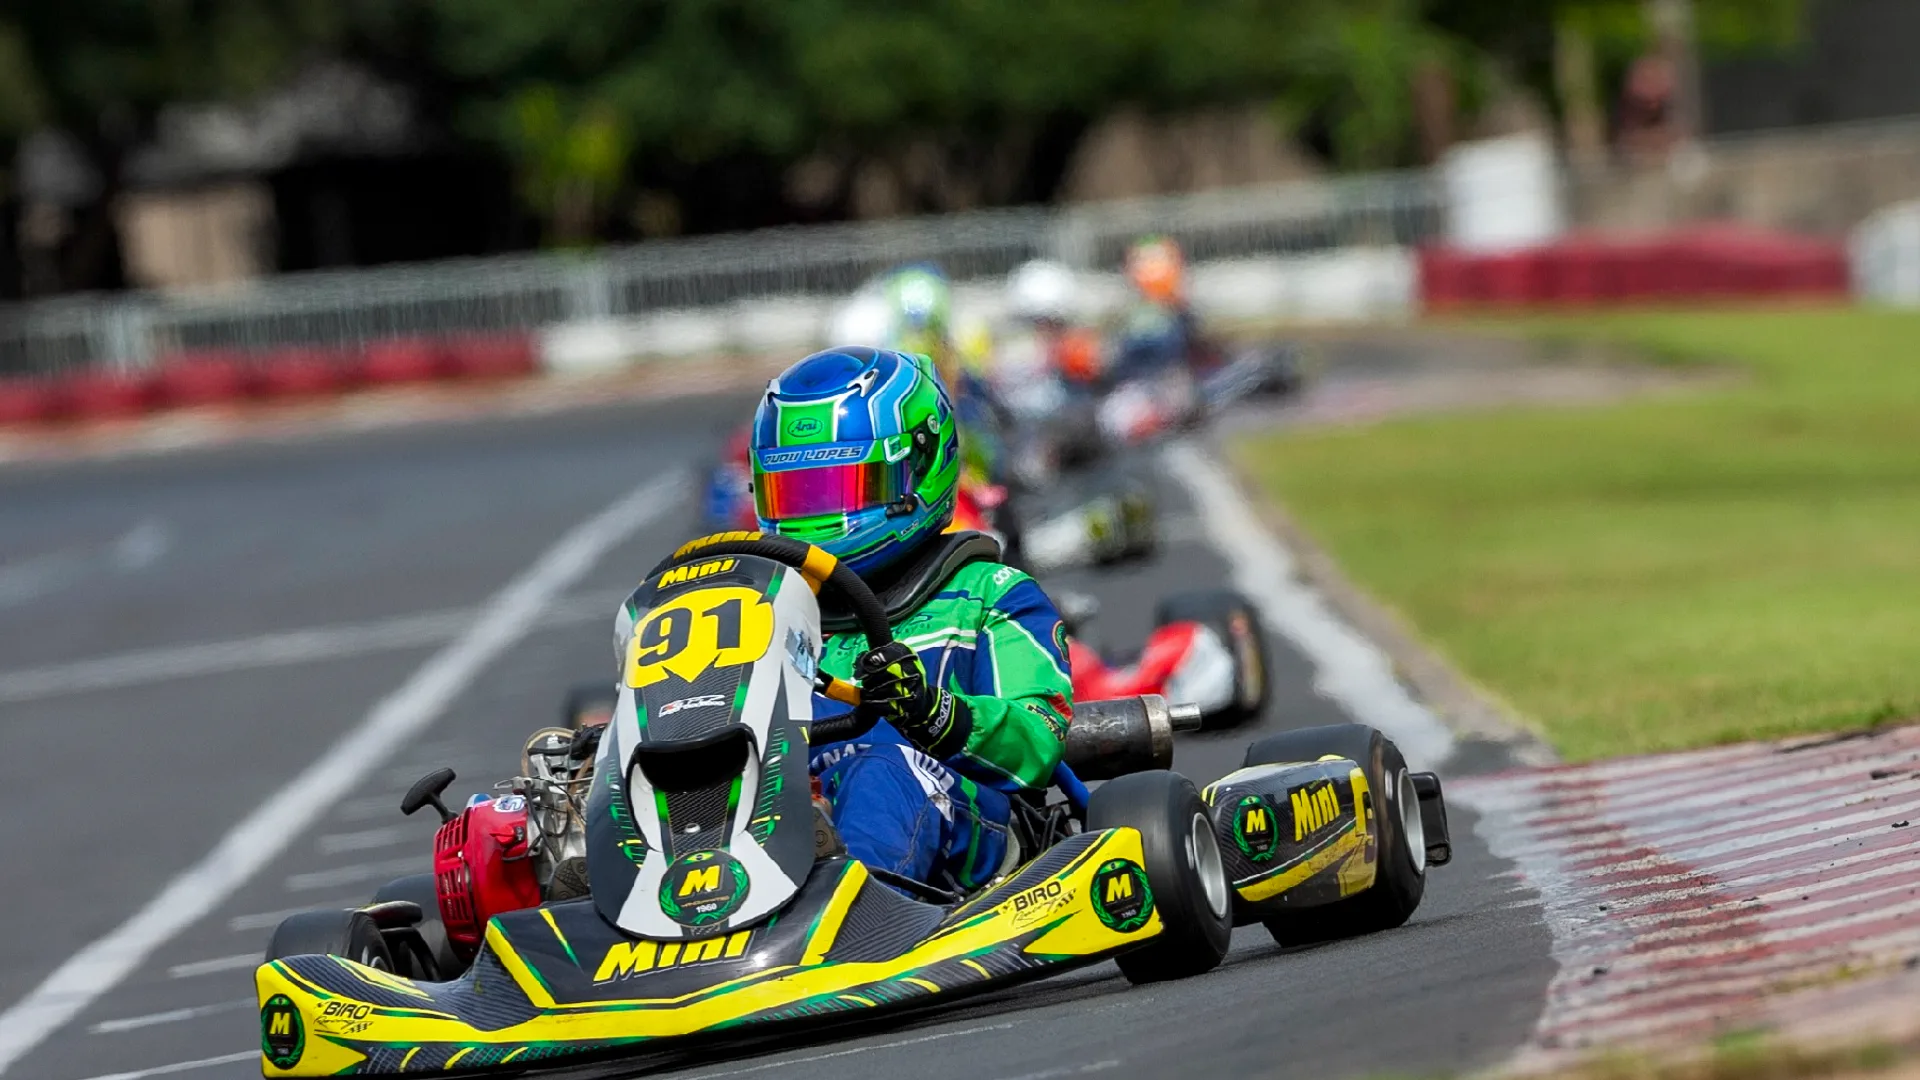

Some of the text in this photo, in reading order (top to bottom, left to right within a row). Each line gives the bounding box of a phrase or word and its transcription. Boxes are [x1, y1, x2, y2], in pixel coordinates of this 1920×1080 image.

[793, 420, 817, 432] Arai
[801, 446, 864, 462] LOPES
[638, 599, 742, 667] 91
[928, 689, 953, 737] sparco
[1246, 809, 1266, 833] M
[678, 865, 721, 897] M
[1106, 873, 1133, 902] M
[1014, 881, 1062, 912] BIRO
[270, 1012, 291, 1035] M
[323, 1001, 371, 1020] BIRO
